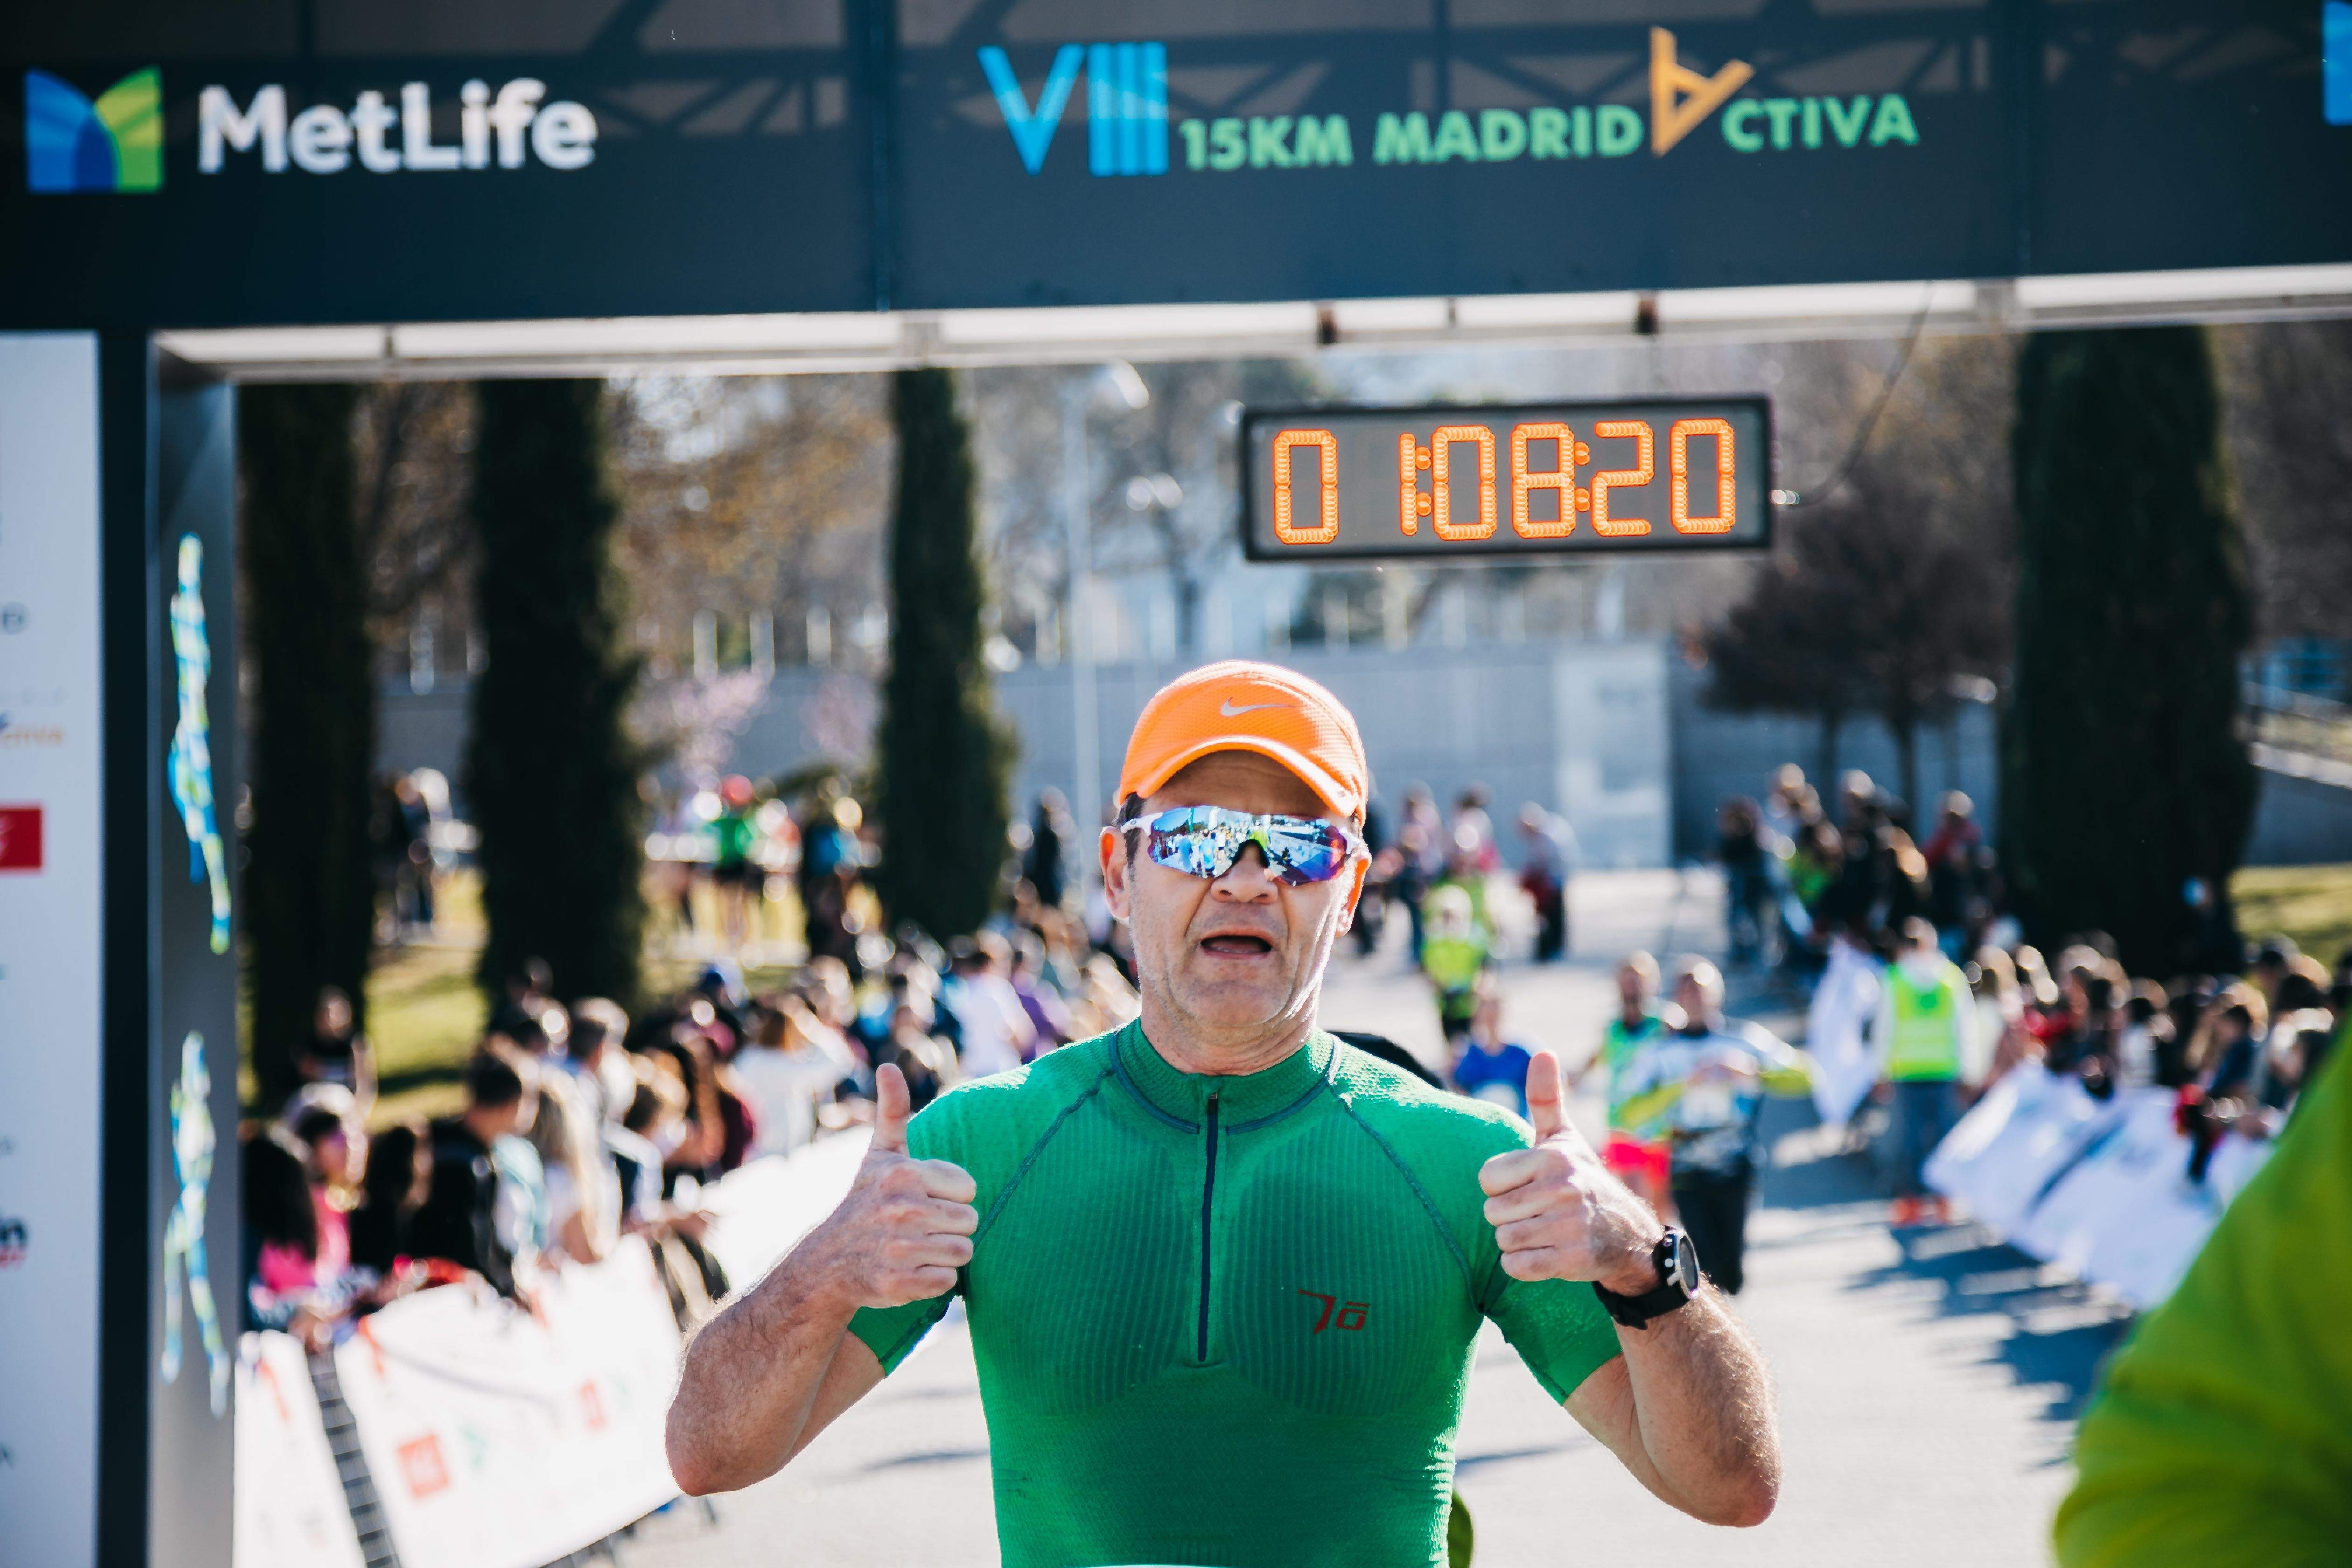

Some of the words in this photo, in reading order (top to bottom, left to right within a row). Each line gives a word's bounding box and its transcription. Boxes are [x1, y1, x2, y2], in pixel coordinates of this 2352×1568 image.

[198, 78, 599, 172] MetLife
[977, 41, 1169, 177] VIII
[1177, 114, 1354, 172] 15KM
[1372, 104, 1644, 165] MADRID
